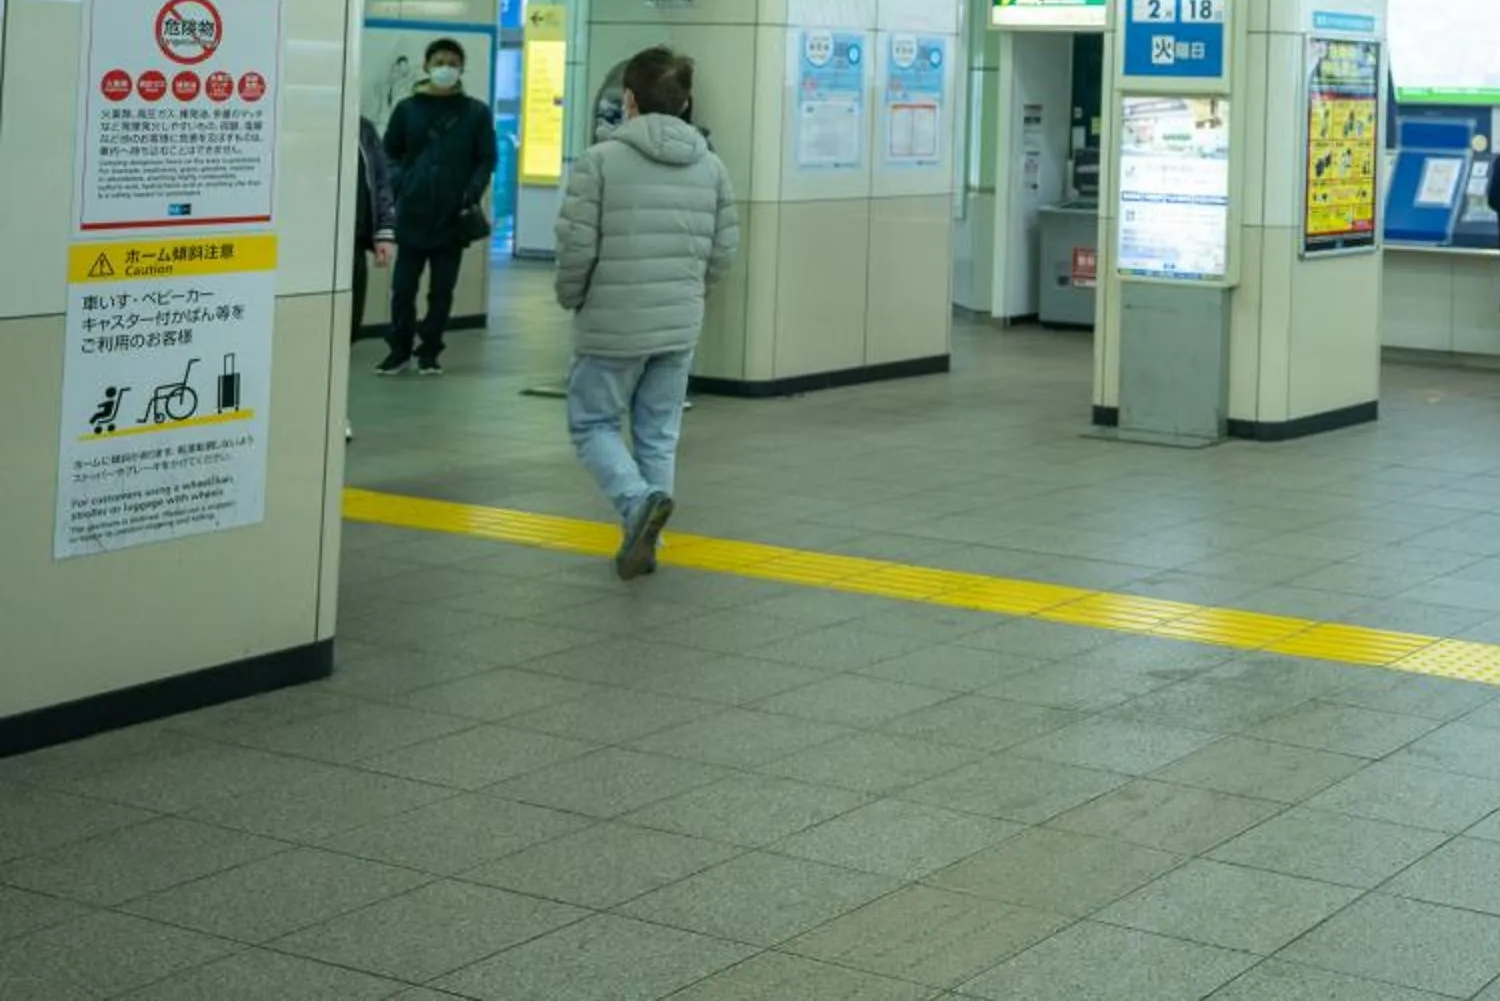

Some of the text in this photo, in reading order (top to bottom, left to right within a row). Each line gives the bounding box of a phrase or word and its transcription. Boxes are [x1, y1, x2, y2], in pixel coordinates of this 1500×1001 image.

[1148, 0, 1213, 20] 2 18
[124, 244, 236, 264] ホーム傾斜注意
[124, 265, 173, 277] Caution
[81, 304, 247, 333] キャスター付かばん等を
[80, 329, 193, 354] ご利用のお客様
